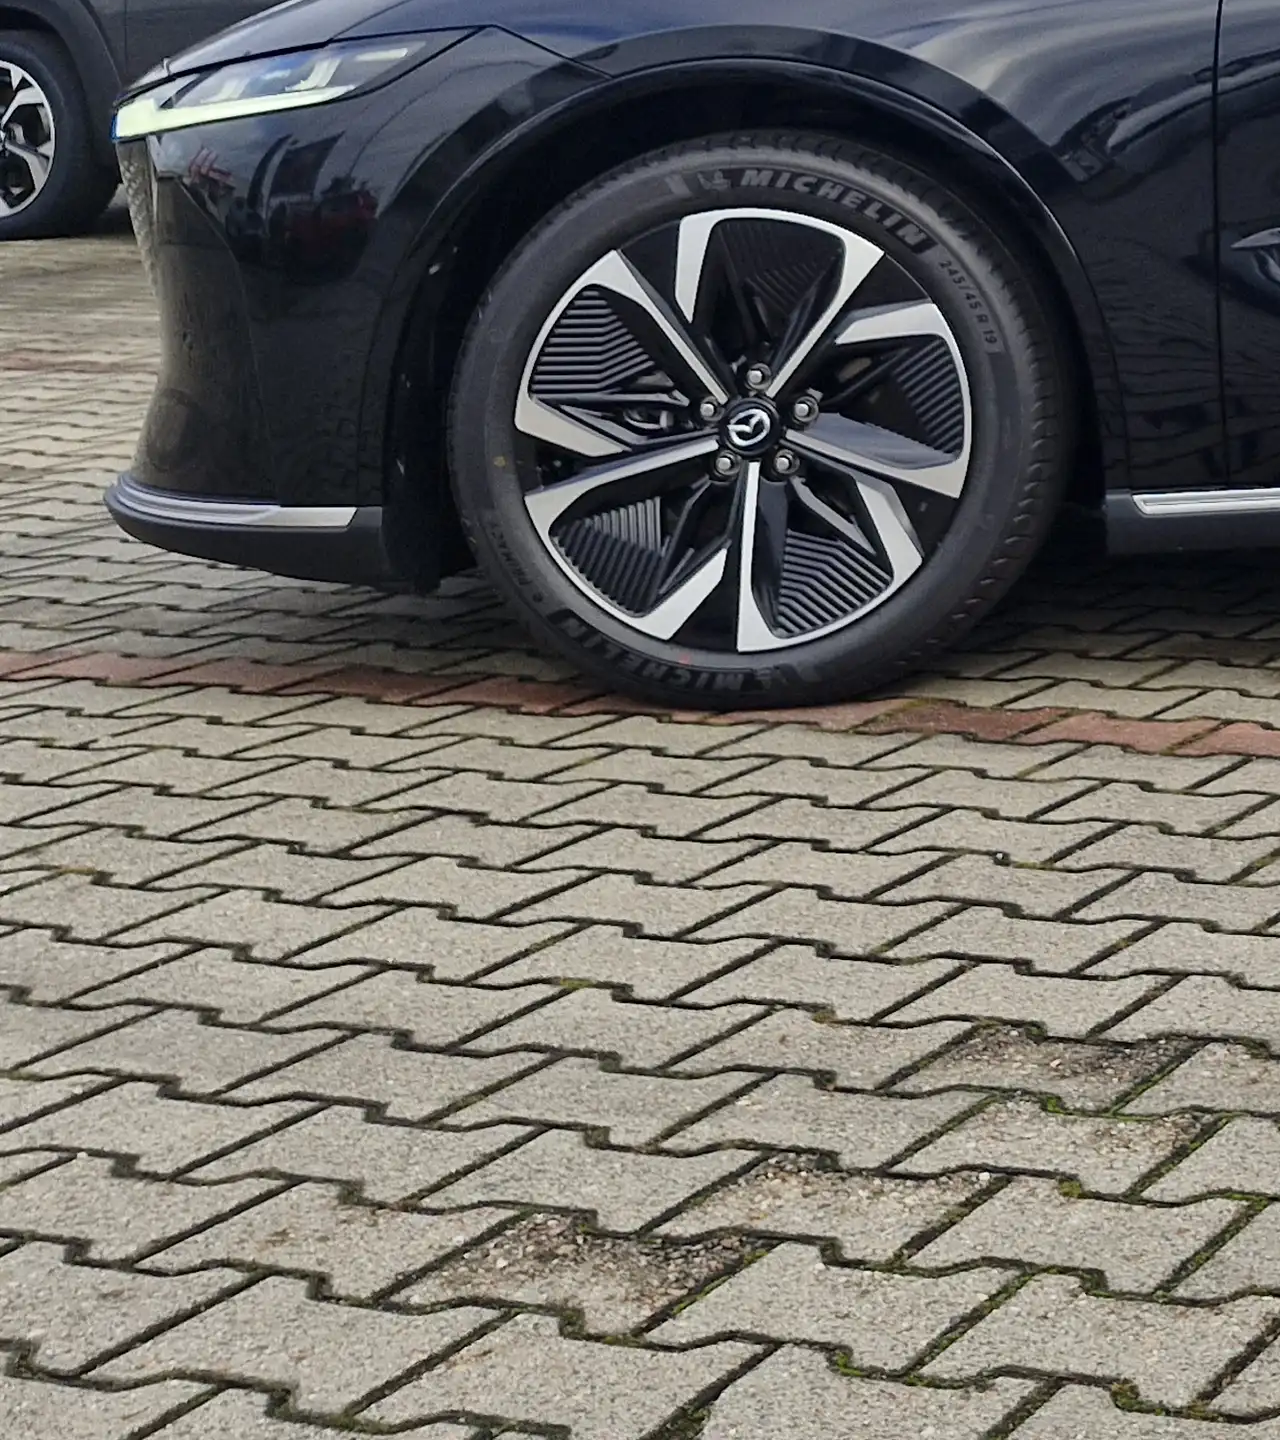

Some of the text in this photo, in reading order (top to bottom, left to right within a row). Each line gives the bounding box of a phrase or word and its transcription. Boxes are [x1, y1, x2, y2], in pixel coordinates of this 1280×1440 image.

[740, 169, 928, 245] MICHELIN
[938, 261, 983, 310] 245/45
[983, 329, 998, 344] 19
